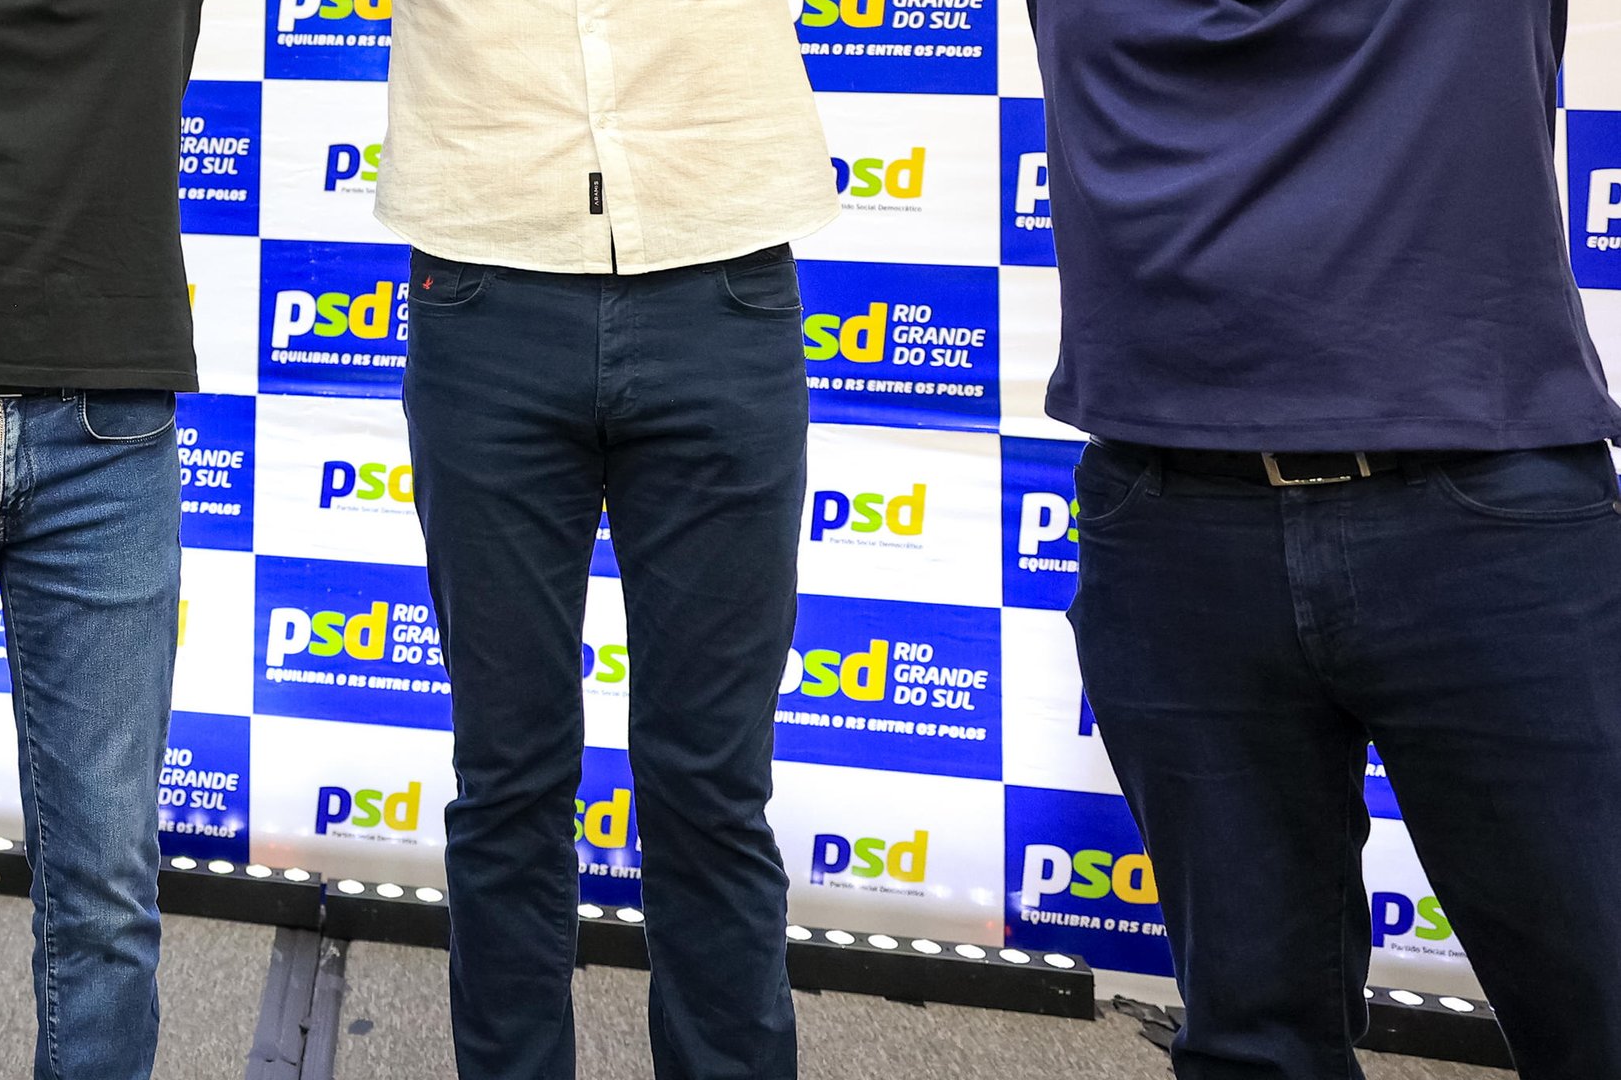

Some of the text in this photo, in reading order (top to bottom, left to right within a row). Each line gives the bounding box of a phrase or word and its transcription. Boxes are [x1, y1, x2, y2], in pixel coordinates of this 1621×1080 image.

[893, 11, 970, 29] DO SUL
[278, 34, 375, 46] EQUILIBRA O RS
[832, 44, 982, 57] O RS ENTRE OS POLOS
[272, 281, 393, 348] psd
[893, 305, 931, 323] RIO
[893, 326, 985, 348] GRANDE
[272, 350, 371, 365] EQUILIBRA O RS
[893, 347, 972, 368] DO SUL
[832, 378, 983, 396] O RS ENTRE OS POLOS
[811, 483, 926, 541] psd
[393, 604, 428, 623] RIO
[266, 601, 388, 666] psd
[392, 645, 422, 663] DO
[894, 642, 933, 662] RIO
[894, 664, 988, 691] GRANDE
[894, 686, 974, 710] DO SUL
[158, 768, 239, 792] GRANDE
[158, 788, 226, 810] DO SUL
[315, 782, 421, 835] psd
[811, 830, 929, 884] psd
[1020, 909, 1139, 932] EQUILIBRA O RS
